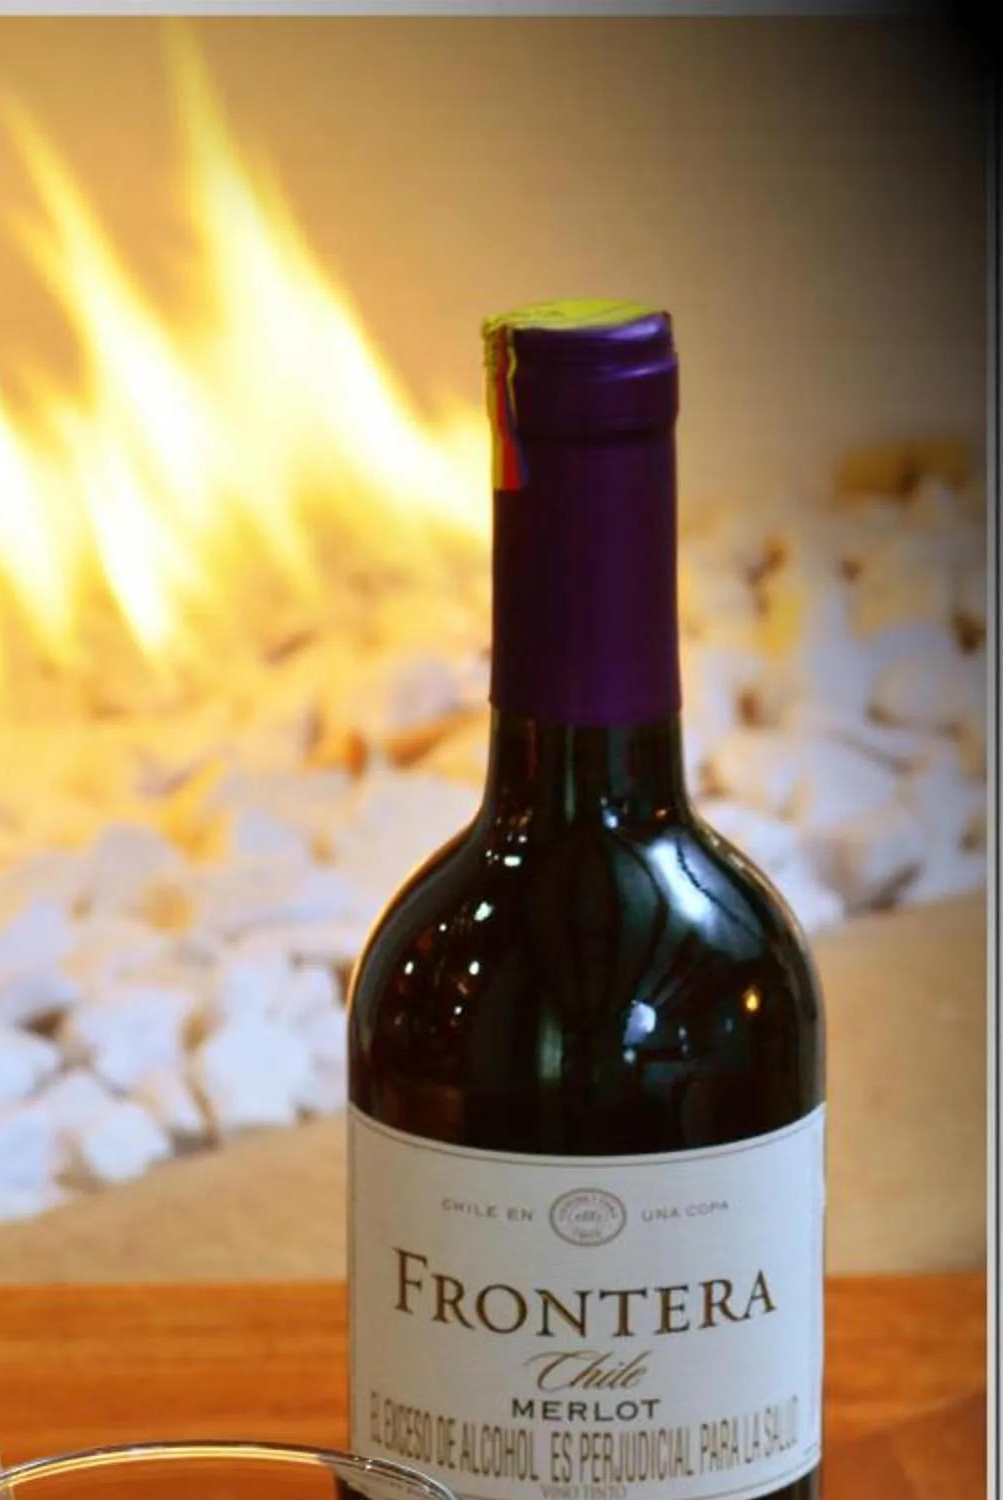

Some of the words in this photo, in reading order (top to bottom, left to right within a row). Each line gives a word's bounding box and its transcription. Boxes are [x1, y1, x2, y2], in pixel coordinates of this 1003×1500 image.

[441, 1197, 497, 1218] CHILE
[506, 1206, 533, 1222] EN
[642, 1205, 682, 1222] UNA
[685, 1200, 729, 1217] COPA
[392, 1246, 778, 1339] FRONTERA
[521, 1348, 652, 1393] Chile
[511, 1397, 662, 1422] MERLOT
[437, 1414, 456, 1470] DE
[460, 1420, 539, 1482] ALCOHOL
[551, 1430, 573, 1483] ES
[580, 1425, 694, 1483] PERJUDICIAL
[700, 1416, 739, 1476] PARA
[744, 1410, 760, 1465] LA
